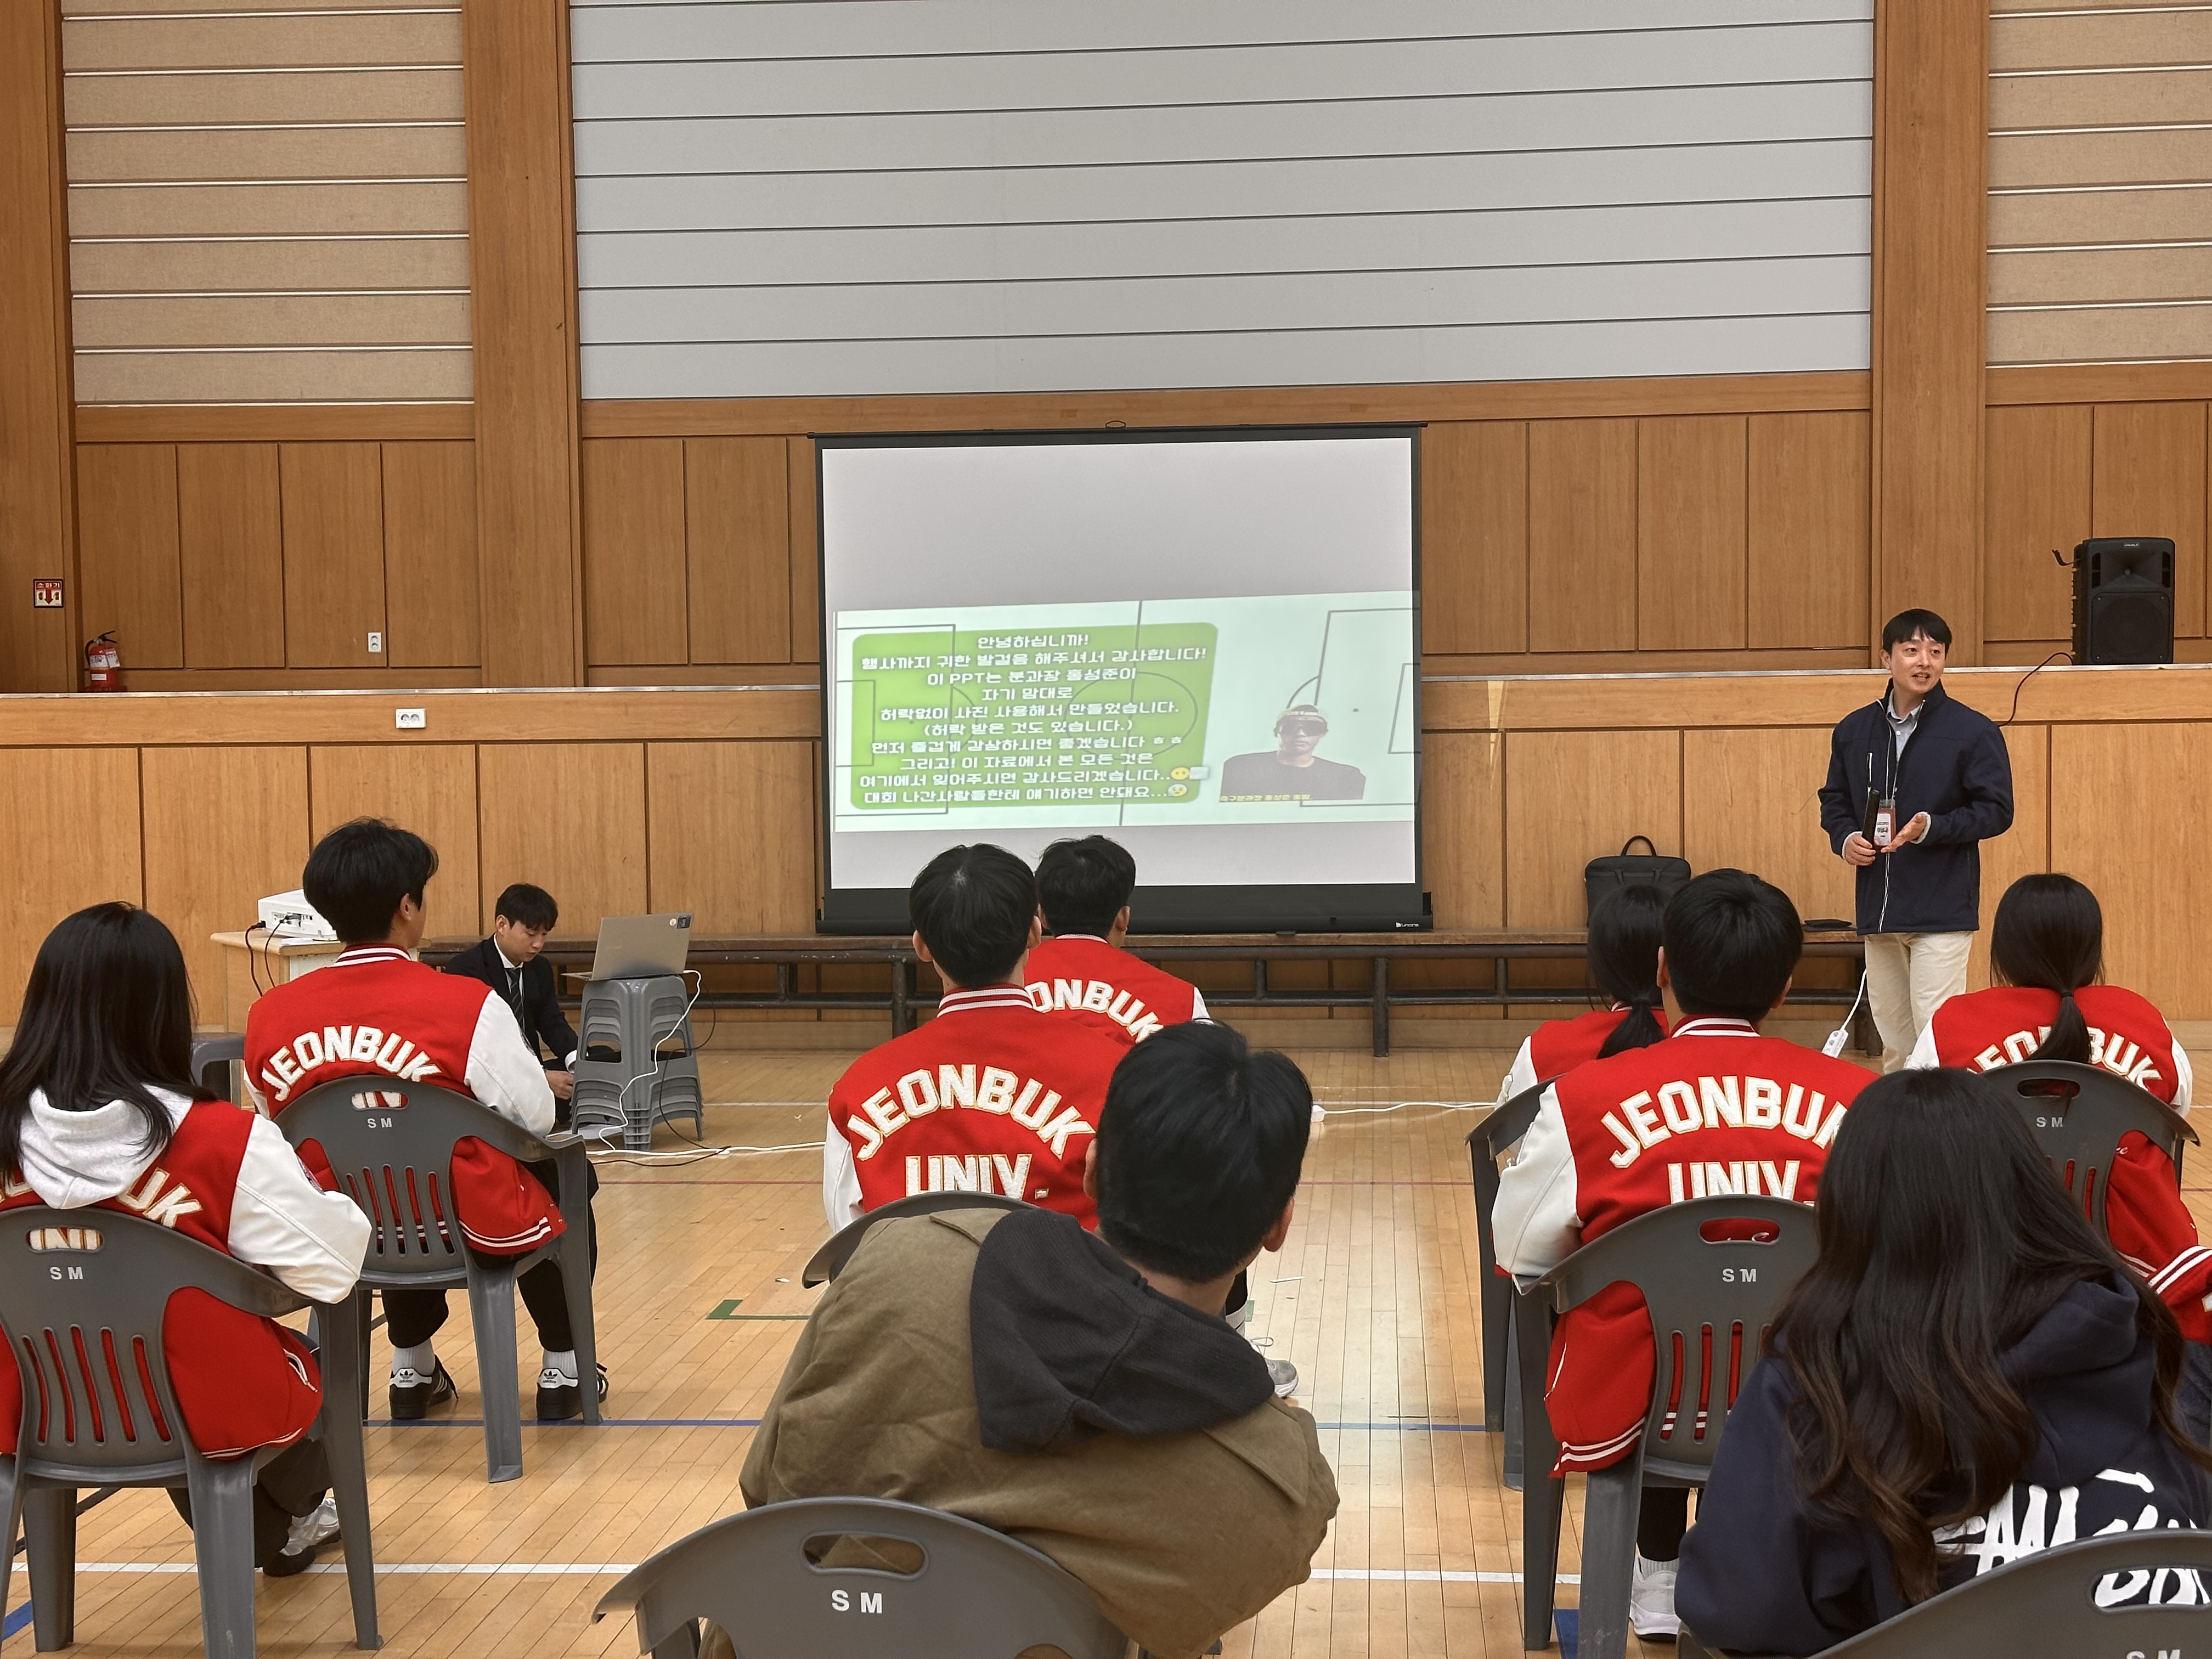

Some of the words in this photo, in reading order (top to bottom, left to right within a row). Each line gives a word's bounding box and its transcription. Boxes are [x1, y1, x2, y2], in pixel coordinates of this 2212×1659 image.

[978, 634, 1088, 649] 안녕하십니까!
[862, 657, 930, 670] 행사까지
[937, 656, 971, 667] 귀한
[977, 653, 1029, 666] 발걸음
[1035, 651, 1105, 665] 해주셔서
[1111, 648, 1206, 662] 감사합니다!
[927, 673, 943, 685] 이
[950, 672, 1002, 684] PPT는
[1008, 670, 1061, 682] 분과장
[981, 689, 1015, 701] 자기
[1022, 687, 1073, 699] 맘대로
[881, 707, 949, 720] 허락없이
[955, 706, 988, 718] 사진
[994, 704, 1063, 718] 사용해서
[1069, 701, 1180, 715] 만들었습니다.
[924, 724, 966, 736] (허락
[971, 723, 1005, 735] 받은
[1011, 721, 1044, 733] 것도
[1051, 720, 1133, 733] 있습니다.)
[872, 742, 905, 754] 먼저
[967, 738, 1052, 752] 감상하시면
[900, 758, 955, 770] 그리고!
[962, 757, 978, 768] 이
[983, 755, 1051, 768] 자료에서
[1057, 755, 1074, 766] 본
[1079, 754, 1114, 766] 모든
[1120, 753, 1154, 765] 것은
[860, 775, 926, 787] 여기에서
[932, 772, 1017, 786] 잊어주시면
[1023, 770, 1170, 784] 감사드리겠습니다..
[864, 792, 896, 803] 대회
[1026, 787, 1093, 800] 얘기하면
[1026, 978, 1164, 1043] ONBUK
[261, 1025, 443, 1102] JEONBUK
[1967, 1026, 2163, 1091] EOBUK
[847, 1064, 1096, 1160] JEONBUK
[905, 1154, 1049, 1201] UNIV.
